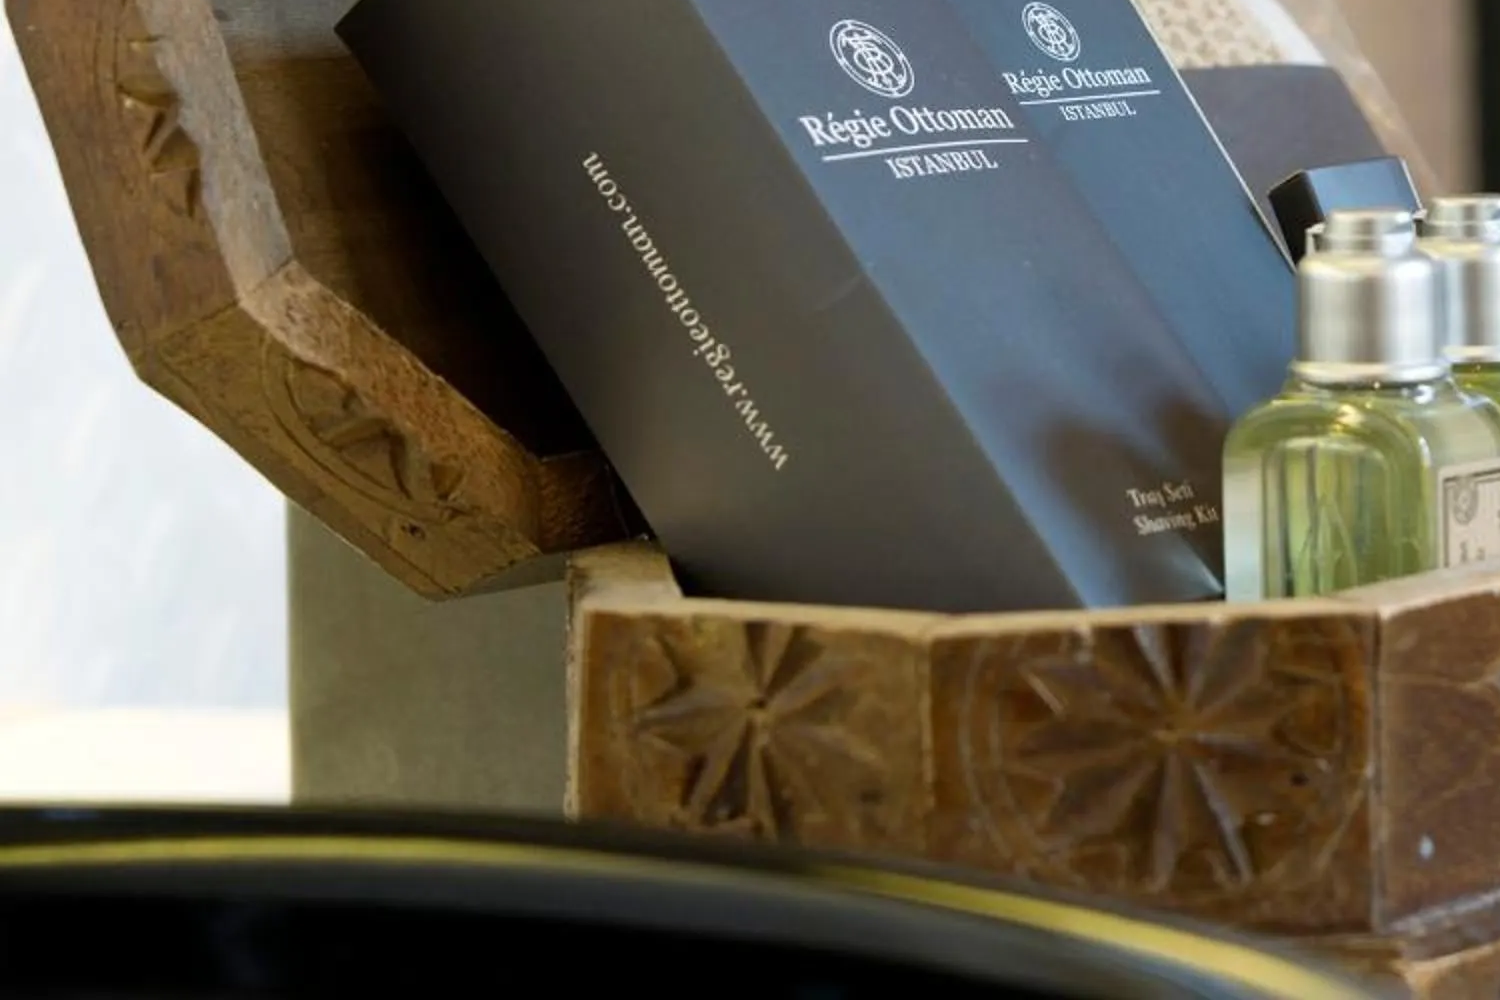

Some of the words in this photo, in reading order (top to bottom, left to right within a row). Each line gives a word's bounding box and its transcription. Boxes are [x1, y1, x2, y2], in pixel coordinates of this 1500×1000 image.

[1002, 70, 1061, 98] Régie
[1062, 66, 1151, 91] Ottoman
[799, 112, 892, 148] Régie
[889, 105, 1014, 135] Ottoman
[1059, 101, 1136, 120] ISTANBUL
[884, 150, 998, 179] ISTANBUL
[582, 152, 789, 470] www.regieottoman.com
